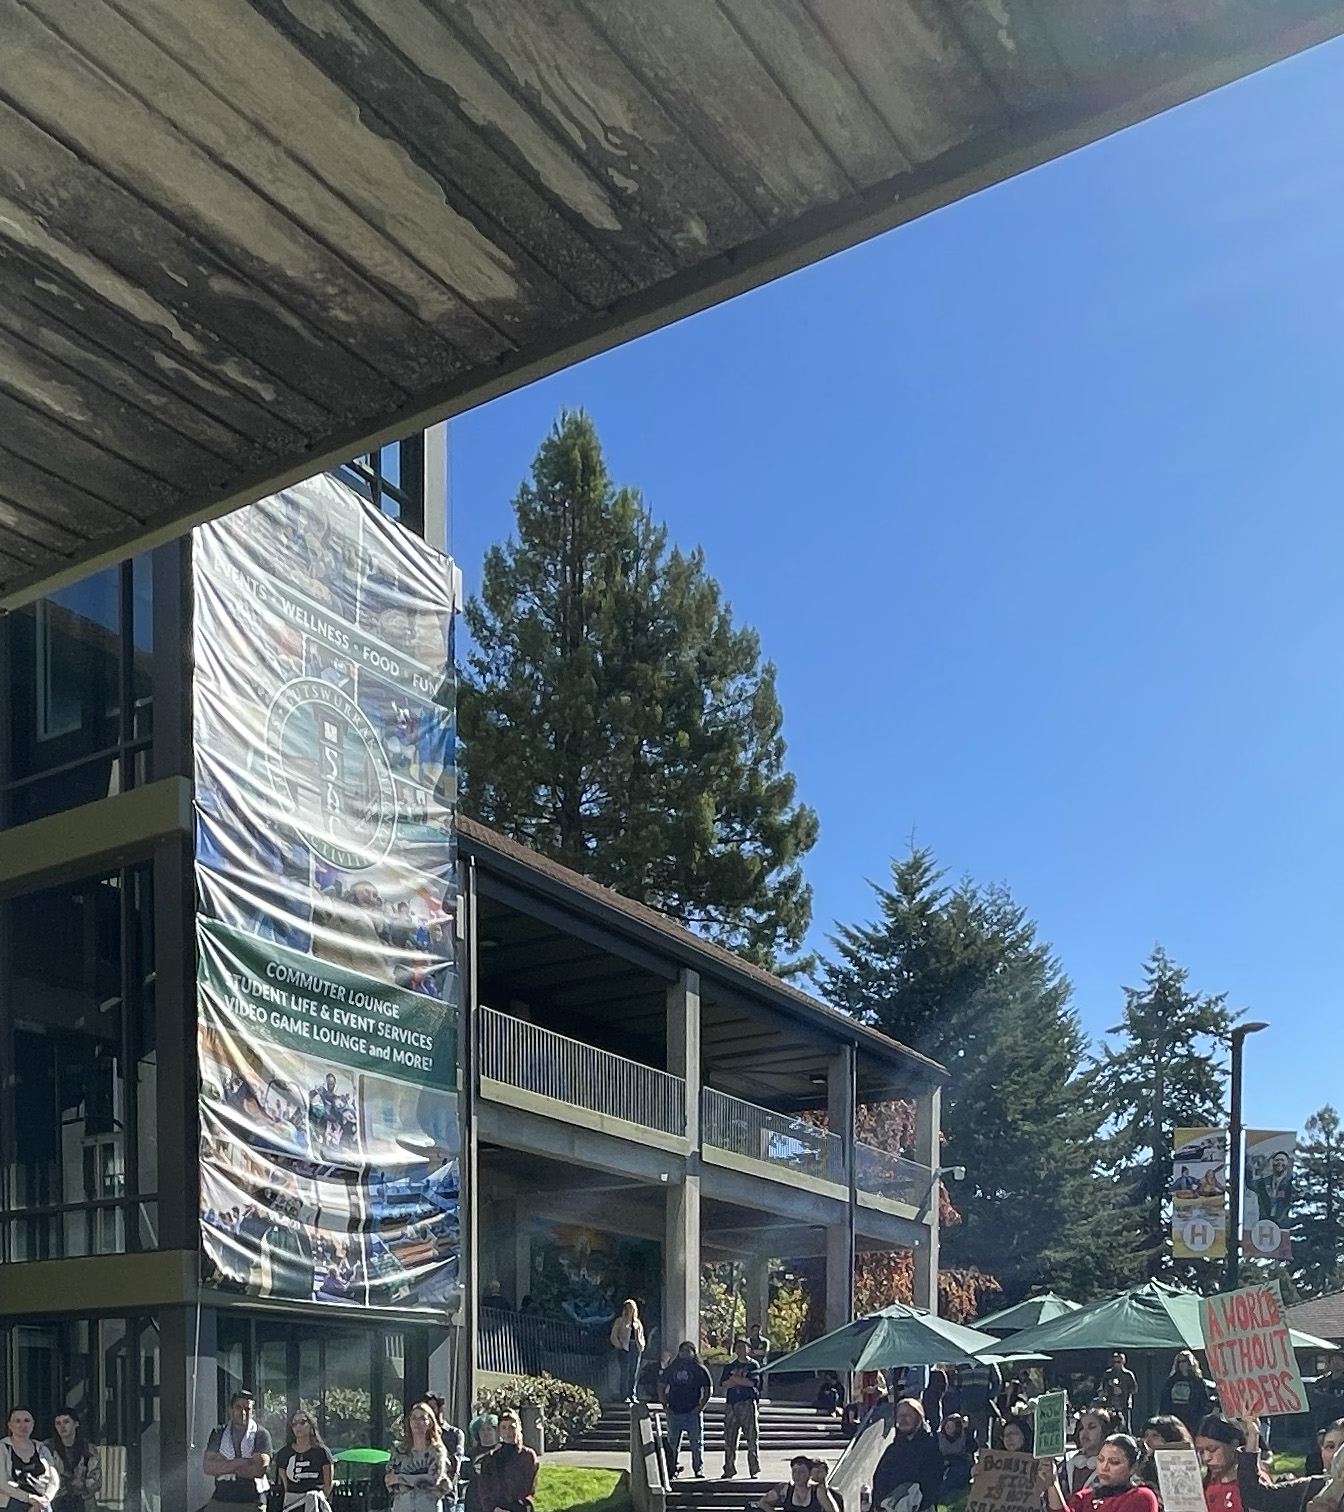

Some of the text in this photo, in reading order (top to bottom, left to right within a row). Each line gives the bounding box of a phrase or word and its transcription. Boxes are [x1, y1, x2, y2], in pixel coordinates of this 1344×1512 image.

[280, 598, 350, 650] WELLNESS
[362, 644, 400, 677] FOOD
[266, 960, 400, 1019] COMMUTER LOUNGE
[224, 994, 434, 1072] VIDEO GAME LOUNGE and MORE!
[291, 993, 318, 1017] LIFE
[320, 1003, 331, 1021] &
[333, 1007, 376, 1035] EVENT
[377, 1022, 434, 1051] SERVICES
[1190, 1224, 1208, 1245] H
[1258, 1225, 1275, 1246] H
[1207, 1289, 1281, 1340] A WORLD
[1207, 1328, 1290, 1378] WITHOUT
[1217, 1370, 1302, 1418] BORDERS
